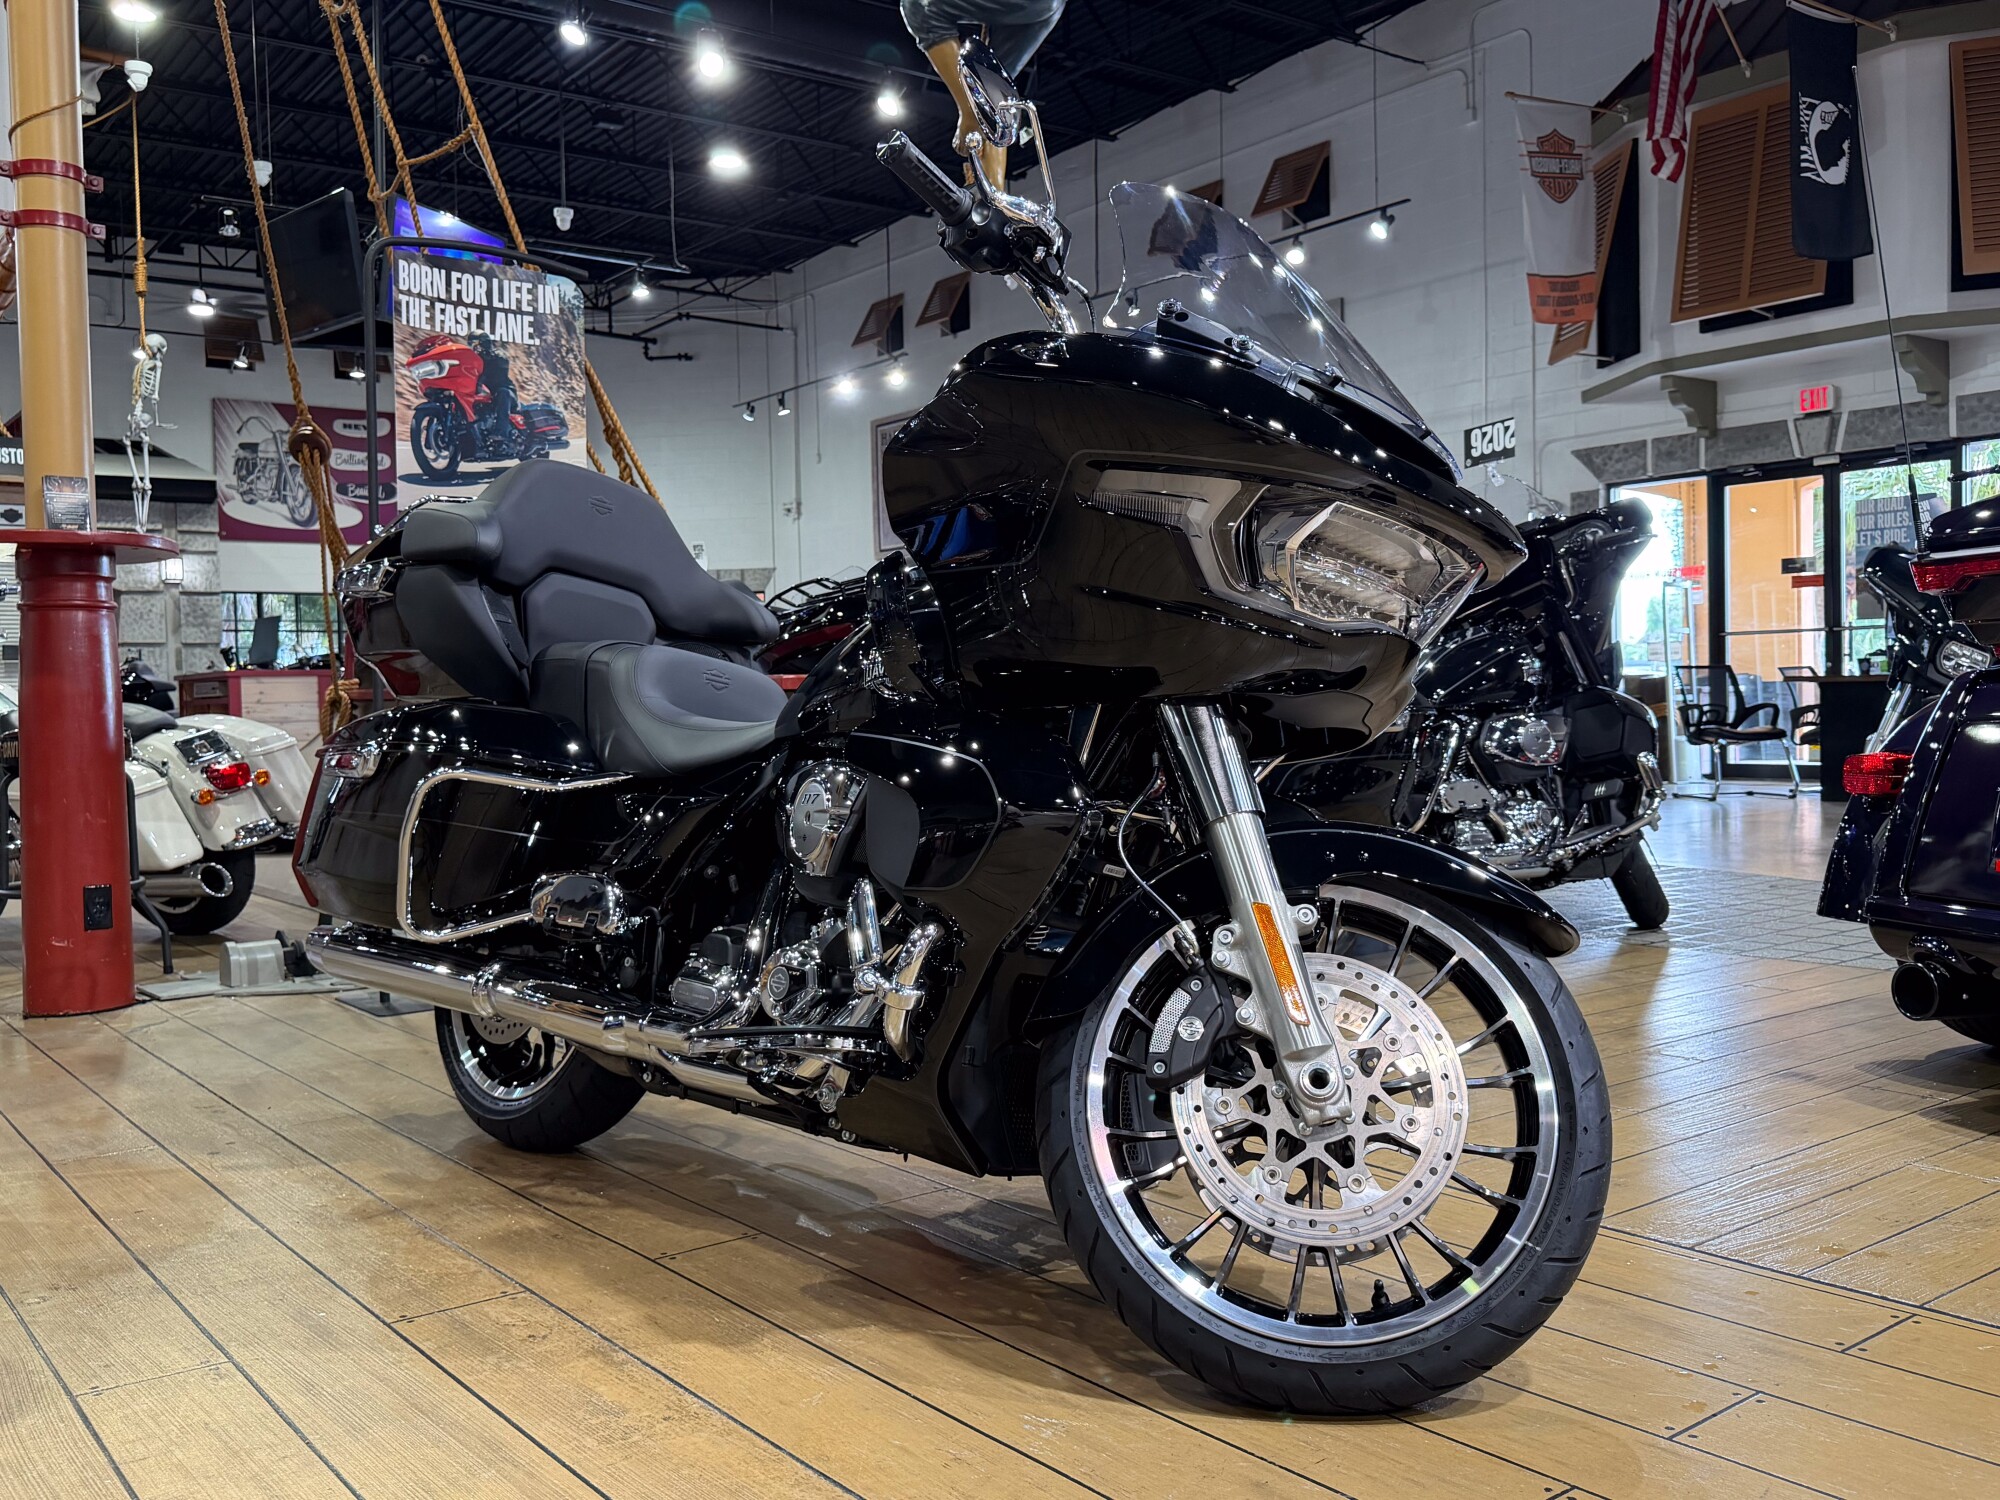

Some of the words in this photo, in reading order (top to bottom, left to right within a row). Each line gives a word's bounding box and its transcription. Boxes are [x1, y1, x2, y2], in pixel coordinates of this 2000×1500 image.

[398, 259, 446, 299] BORN
[451, 271, 487, 306] FOR
[493, 278, 533, 312] LIFE
[538, 284, 559, 315] IN
[399, 294, 431, 331] THE
[435, 302, 480, 336] FAST
[484, 310, 540, 345] LANE.
[1800, 386, 1828, 412] EXIT
[0, 448, 24, 465] STO
[1877, 511, 1912, 528] RULES.
[1884, 528, 1910, 545] RIDE.
[801, 793, 821, 805] 117
